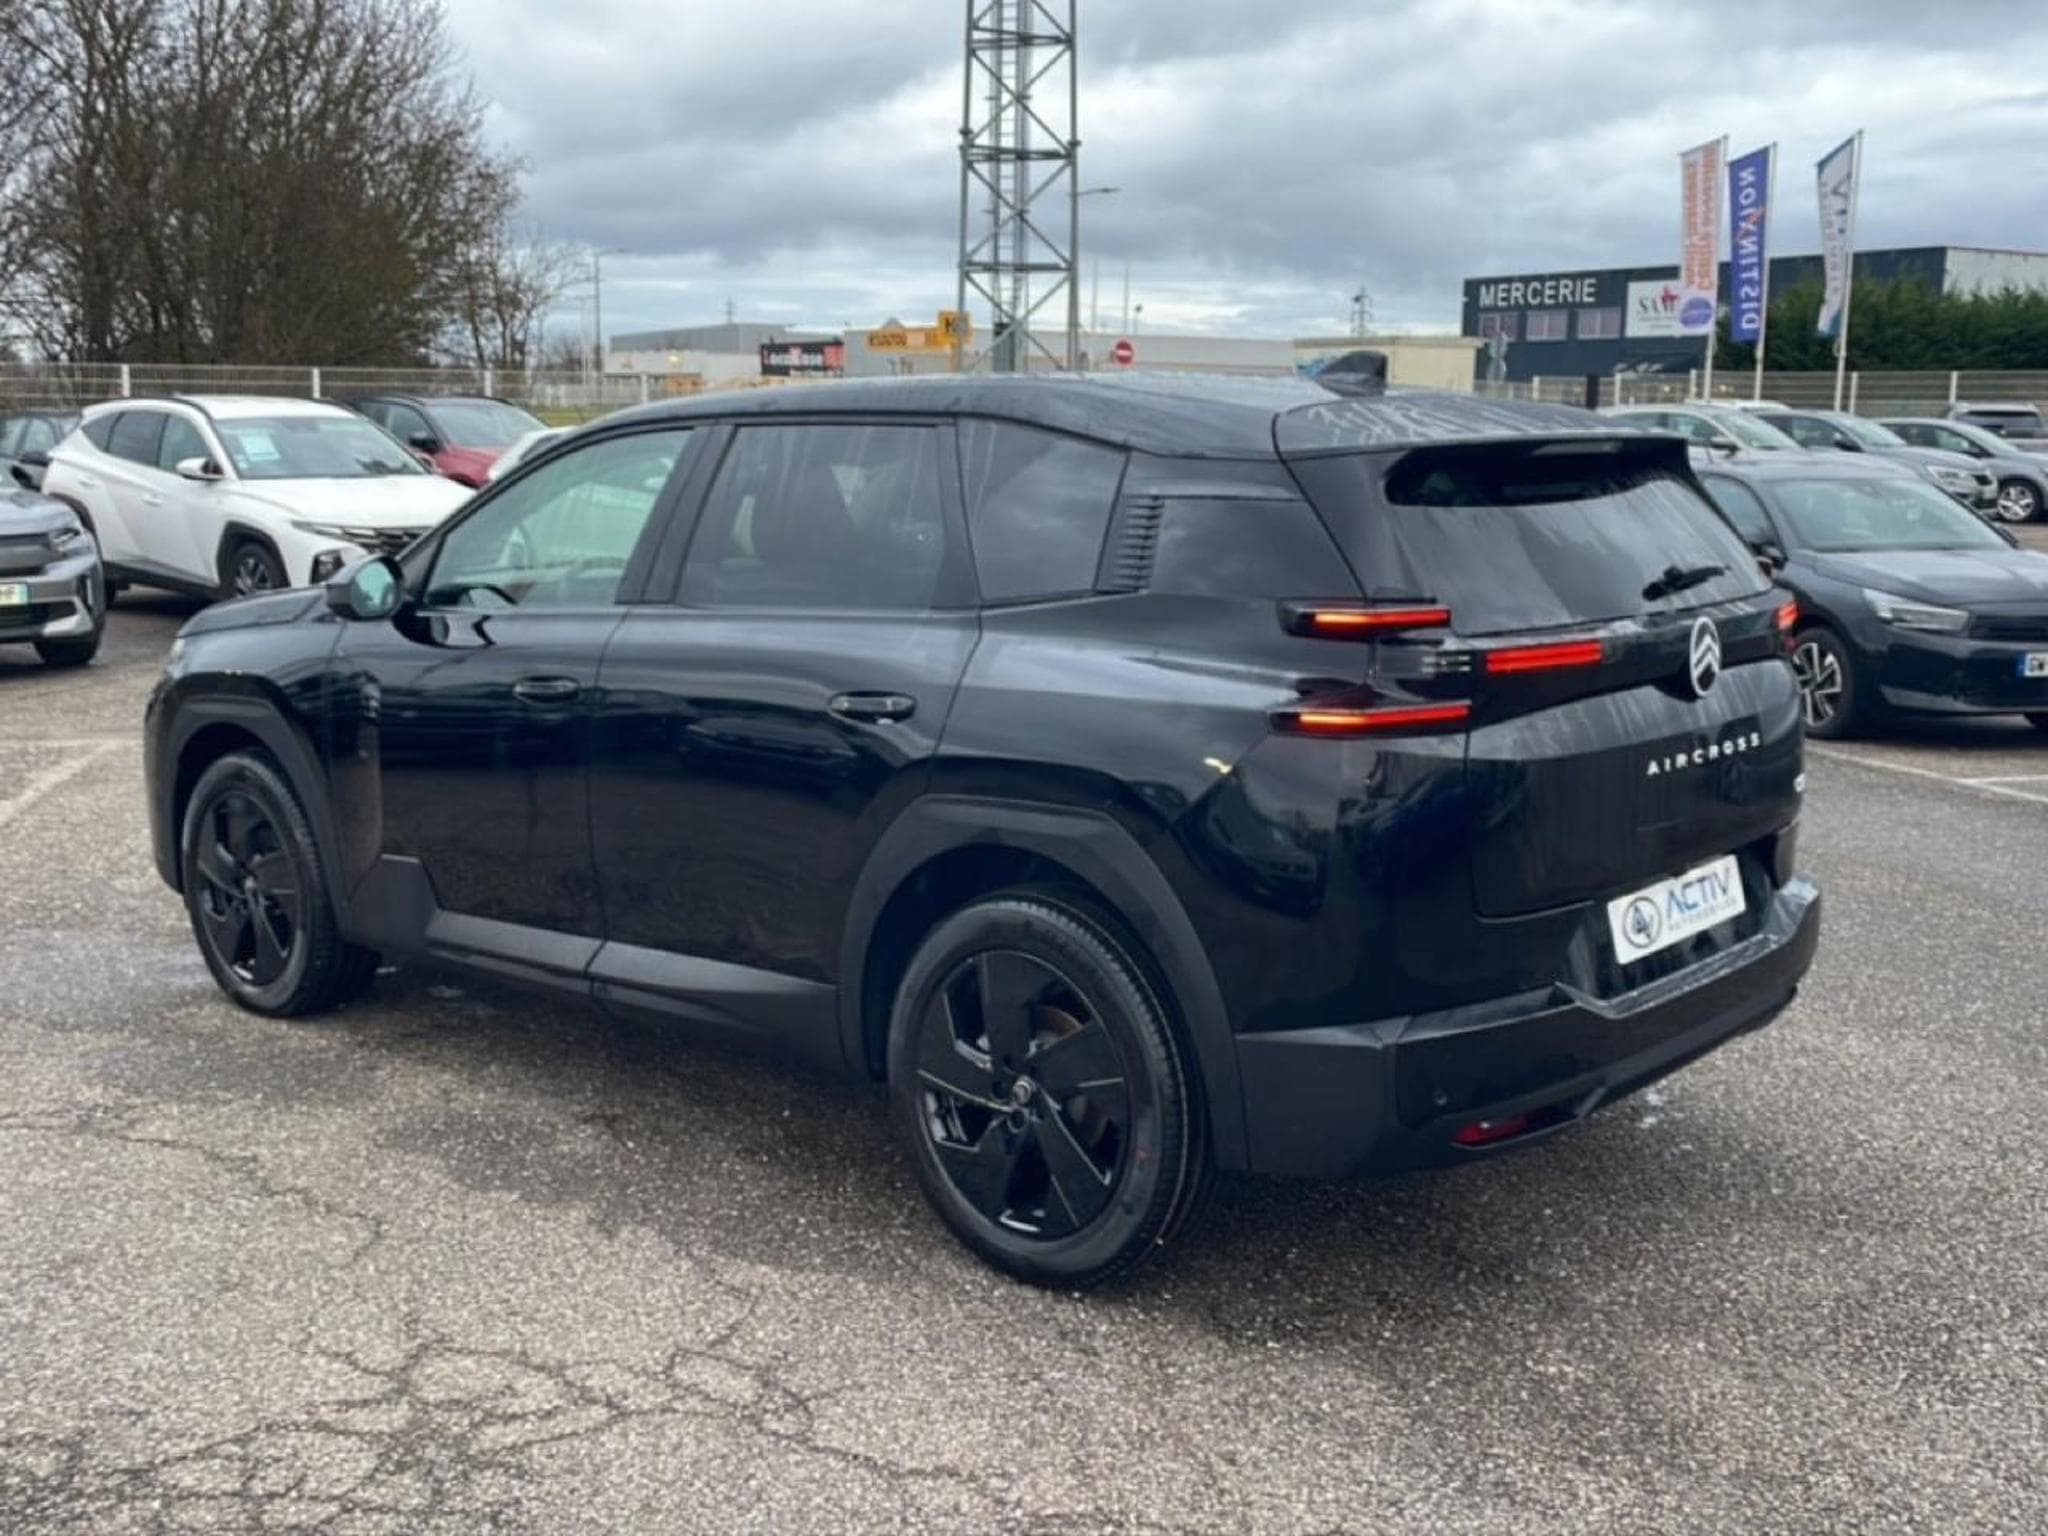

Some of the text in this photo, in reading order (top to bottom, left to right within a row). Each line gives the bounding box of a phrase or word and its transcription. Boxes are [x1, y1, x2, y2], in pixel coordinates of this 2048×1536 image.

[1479, 278, 1598, 307] MERCERIE
[1646, 732, 1760, 776] AIRCROSS
[1665, 865, 1730, 922] ACTIV
